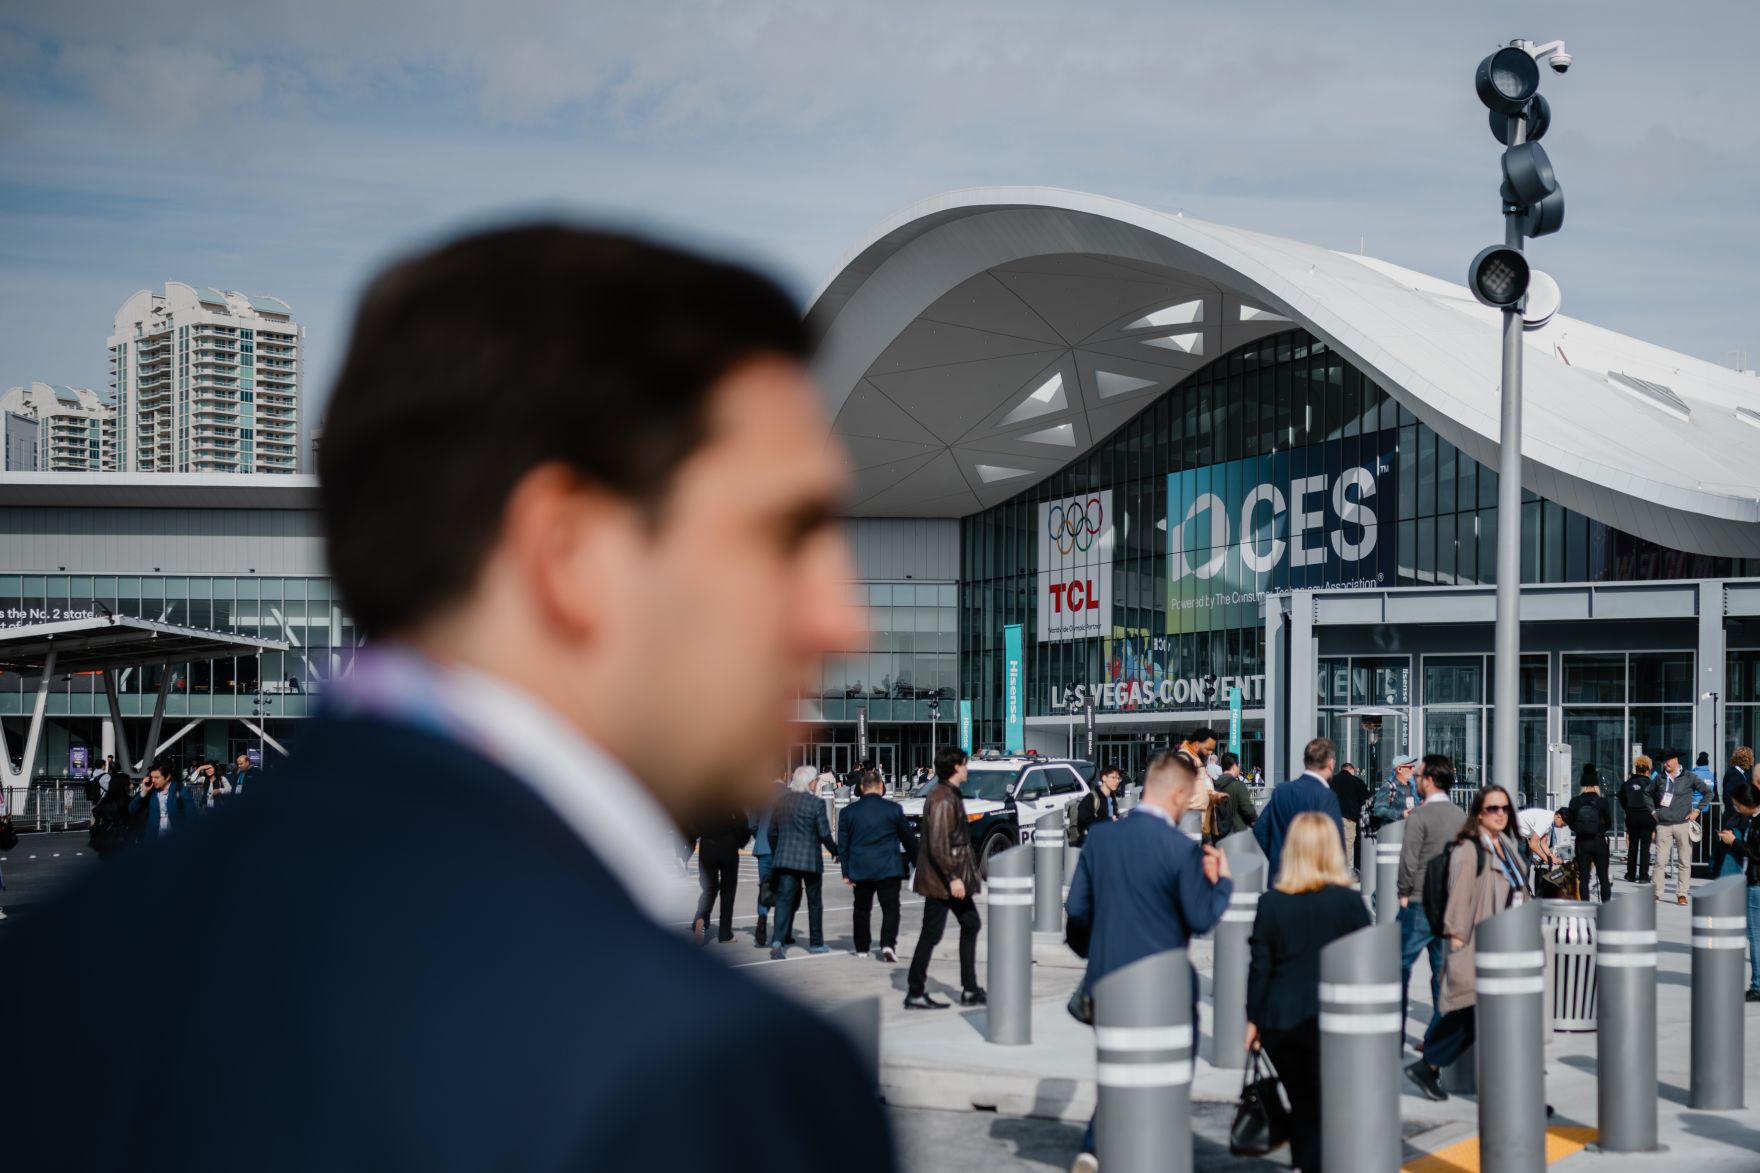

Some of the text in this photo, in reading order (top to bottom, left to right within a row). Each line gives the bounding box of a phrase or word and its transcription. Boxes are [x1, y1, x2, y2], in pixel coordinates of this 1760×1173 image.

[1049, 579, 1099, 613] TCL
[7, 608, 27, 619] the
[29, 608, 50, 619] No.
[52, 608, 60, 619] 2
[63, 609, 94, 619] state
[1009, 660, 1018, 723] Hisense
[1089, 681, 1155, 707] VEGAS
